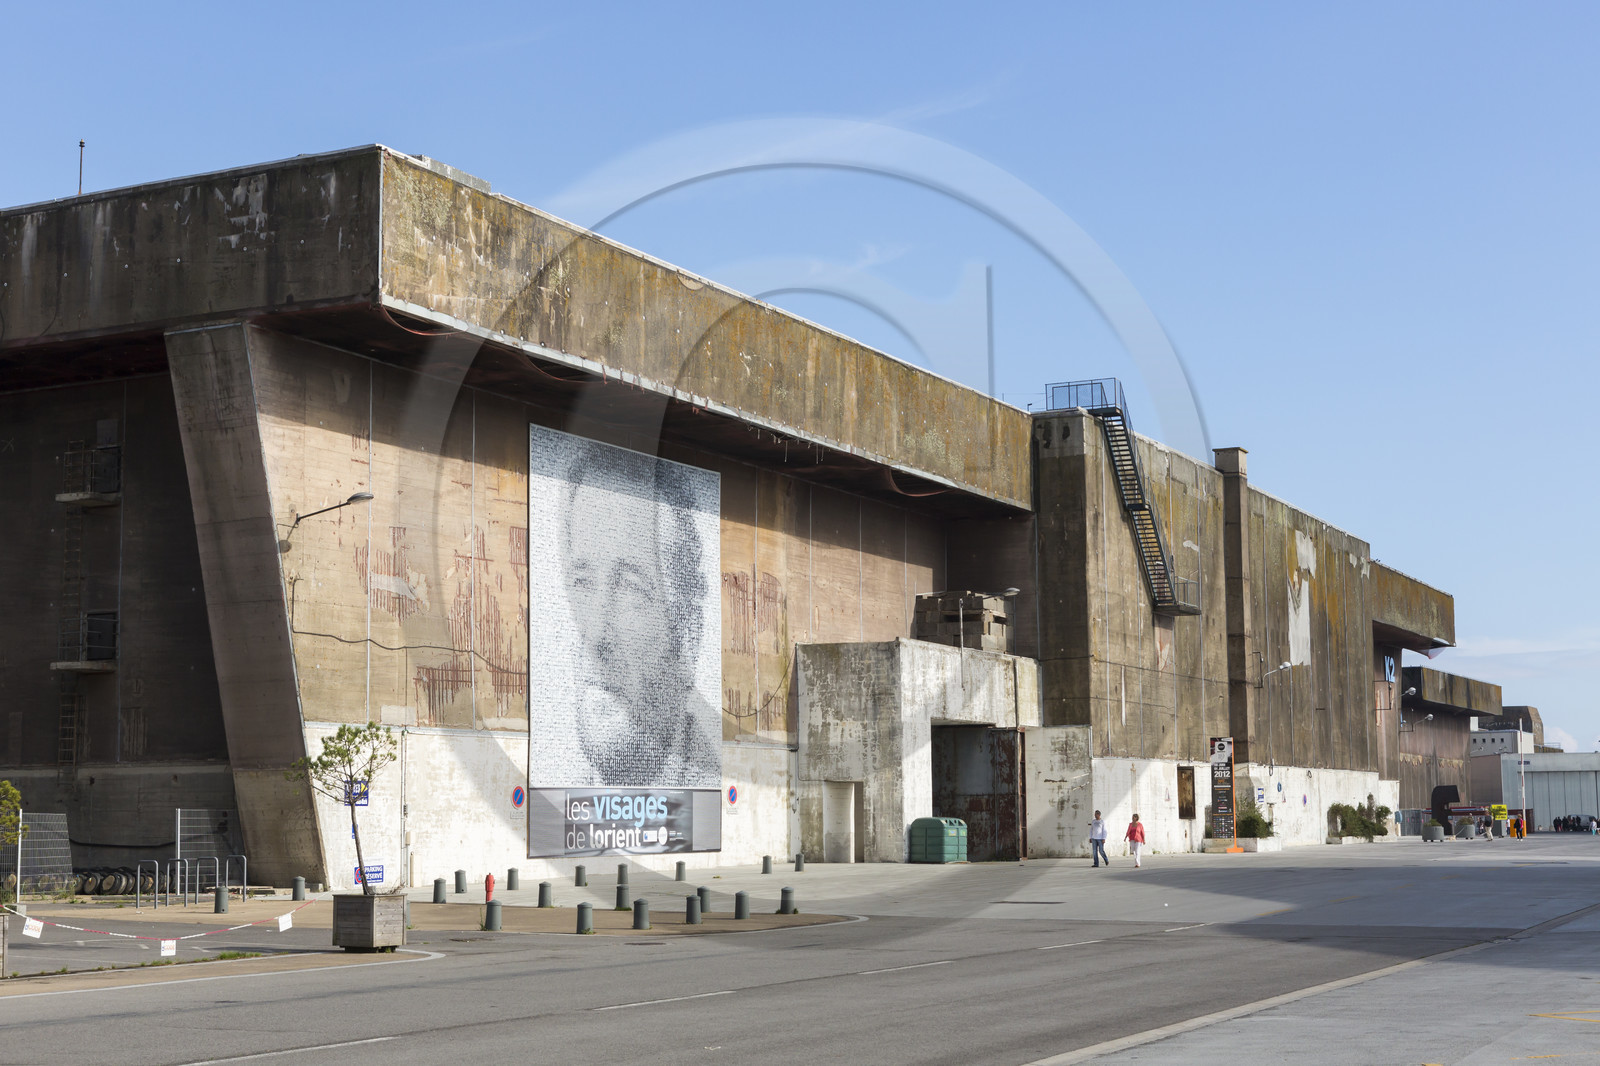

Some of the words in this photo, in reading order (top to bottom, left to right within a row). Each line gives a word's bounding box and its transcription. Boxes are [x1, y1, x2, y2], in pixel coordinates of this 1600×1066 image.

[1384, 655, 1396, 683] K2
[1214, 770, 1231, 778] 2012
[566, 793, 590, 821] les
[593, 789, 668, 828] visages
[566, 823, 586, 850] de
[589, 823, 642, 849] lorient
